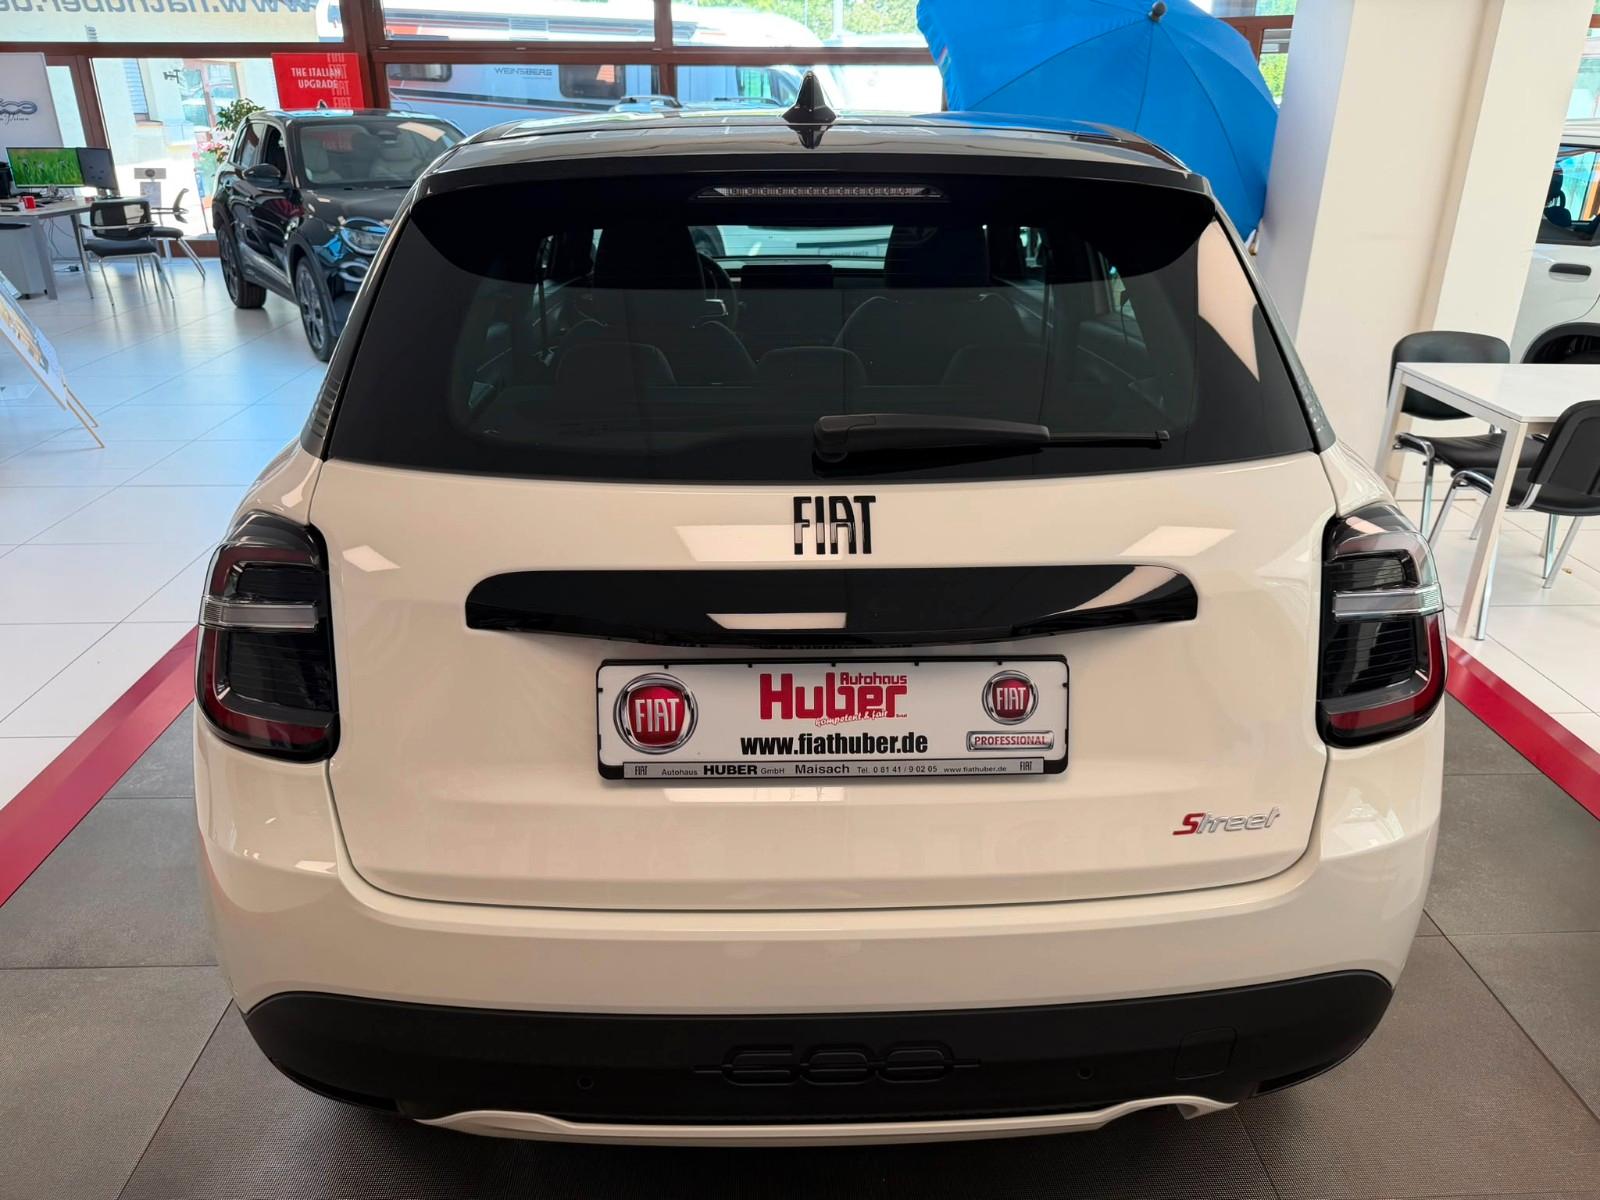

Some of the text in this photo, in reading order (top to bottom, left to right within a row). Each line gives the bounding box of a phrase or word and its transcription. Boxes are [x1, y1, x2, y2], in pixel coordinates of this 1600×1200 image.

[291, 67, 341, 78] THE ITALIAN
[298, 79, 339, 89] UPGRADE
[793, 496, 876, 555] FIAT
[840, 672, 908, 686] Autohaus
[759, 672, 908, 720] Huber
[996, 687, 1026, 710] FIAT
[635, 698, 680, 732] FIAT
[740, 732, 928, 755] www.fiathuber.de
[974, 735, 1047, 746] PROFESSIONAL
[634, 766, 648, 776] FIAT
[661, 768, 698, 776] Autohaus
[703, 765, 758, 775] HUBER
[760, 767, 785, 775] GmbH
[795, 764, 850, 774] Maisach
[1020, 761, 1033, 771] FIAT
[1172, 806, 1280, 835] Street
